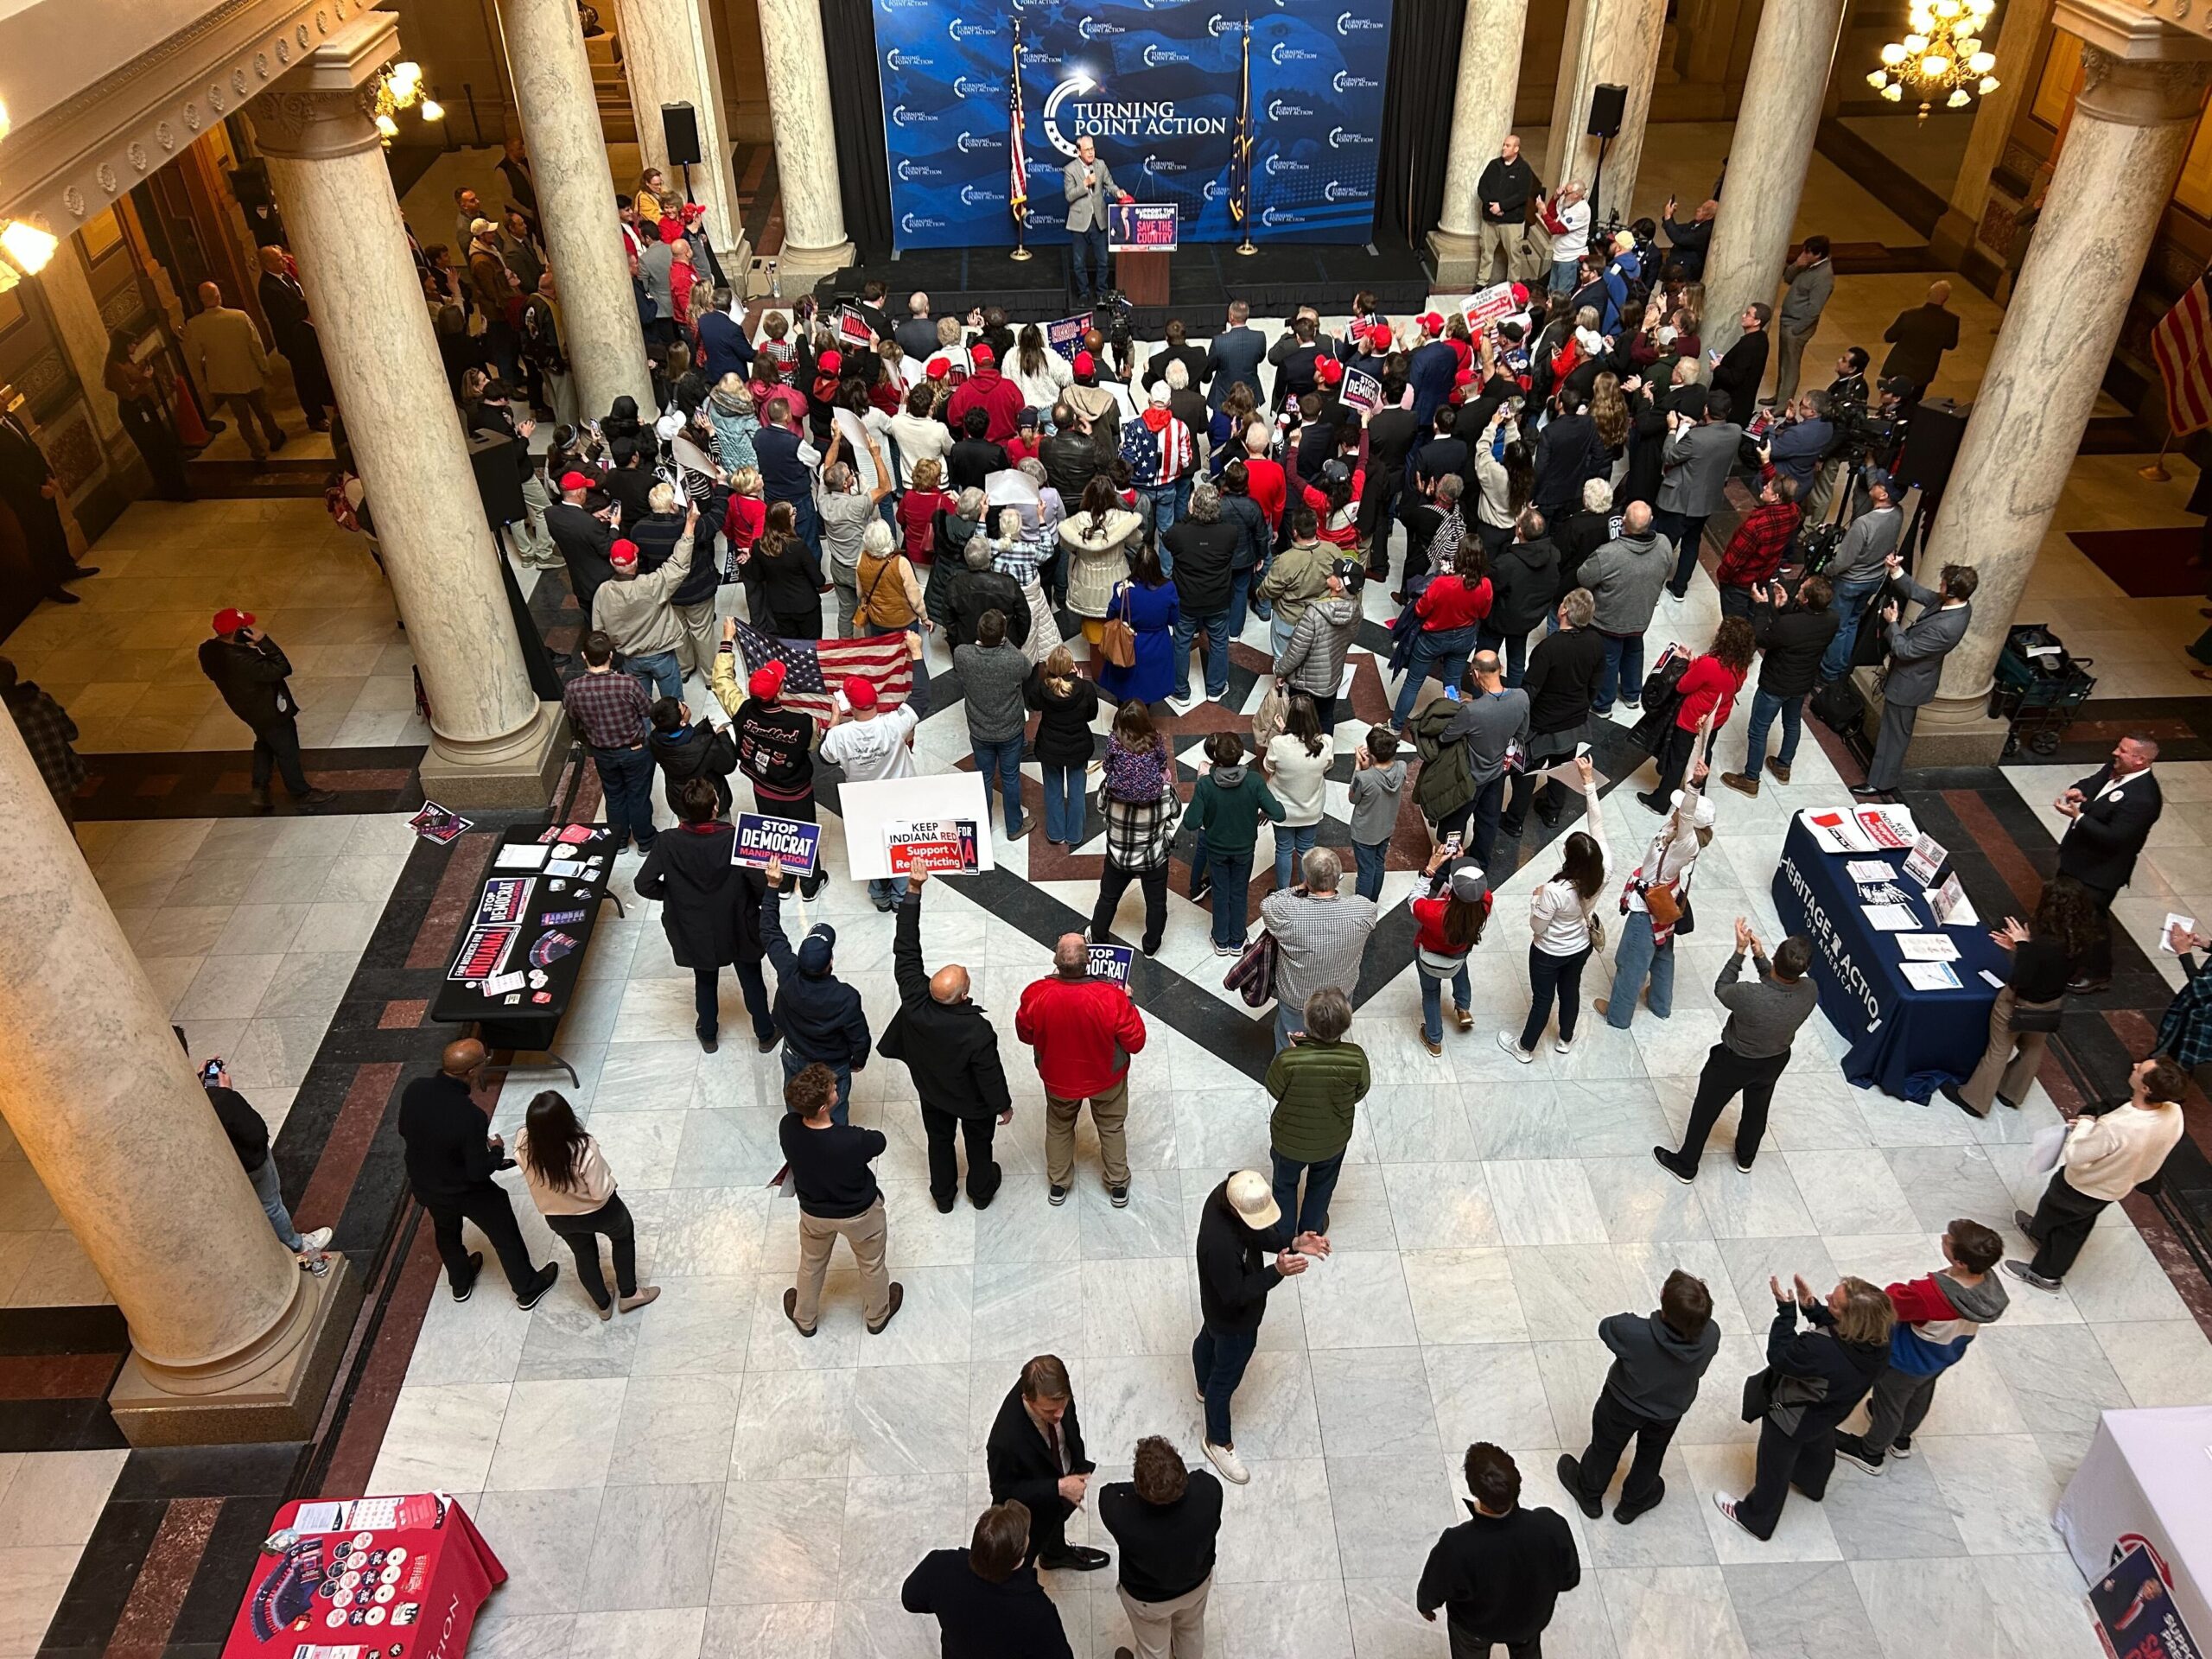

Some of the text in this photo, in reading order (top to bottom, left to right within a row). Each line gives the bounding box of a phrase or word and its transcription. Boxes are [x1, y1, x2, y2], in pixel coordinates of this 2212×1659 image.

[1073, 102, 1174, 119] TURNING
[1074, 118, 1227, 136] POINT ACTION
[1137, 220, 1173, 232] SAVE THE
[1137, 232, 1173, 243] COUNTRY
[1360, 375, 1375, 389] STOP
[762, 820, 798, 835] STOP
[912, 823, 938, 832] KEEP
[958, 827, 972, 837] FOR
[1879, 811, 1903, 837] INDIANA
[1896, 823, 1912, 837] KEEP
[741, 828, 813, 856] DEMOCRAT
[890, 832, 957, 843] INDIANA RED
[740, 848, 808, 865] MANIPATION
[907, 845, 948, 857] Support
[896, 857, 960, 869] Retricting
[483, 892, 496, 912] STOP
[490, 882, 515, 921] DEMOCRAT
[506, 880, 523, 920] MANIPULATION
[1779, 854, 1831, 939] HERITAGE
[454, 933, 484, 976] FAIR DISTRICTS FOR
[465, 933, 507, 977] INDIANA
[1088, 948, 1114, 959] TOP
[1804, 910, 1852, 994] FOR AMERICA
[1086, 959, 1127, 980] OCRAT
